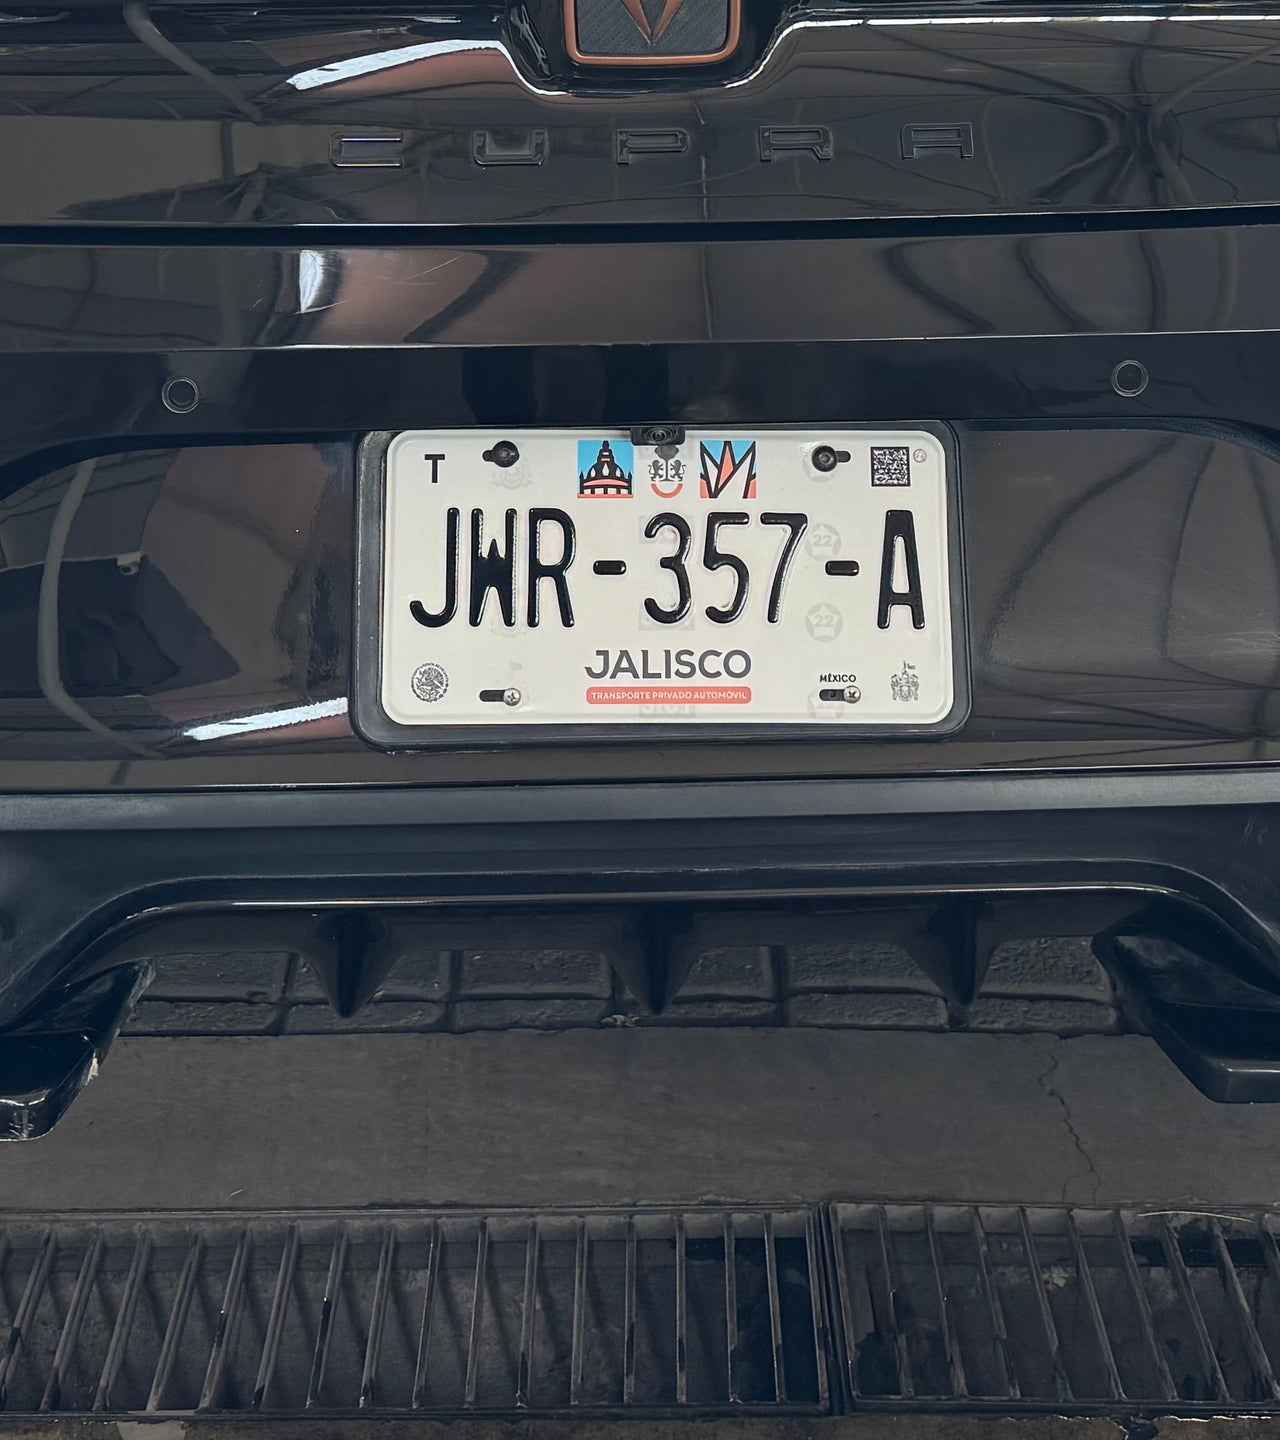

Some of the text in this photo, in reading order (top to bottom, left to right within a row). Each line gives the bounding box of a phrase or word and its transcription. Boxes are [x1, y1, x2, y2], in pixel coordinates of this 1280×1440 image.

[329, 122, 976, 169] CUPRA
[424, 453, 446, 484] T
[409, 506, 927, 630] JWR-357-A
[584, 649, 752, 679] JALISCO
[591, 691, 651, 700] TRANSPORTE
[652, 691, 692, 700] PRIVADO
